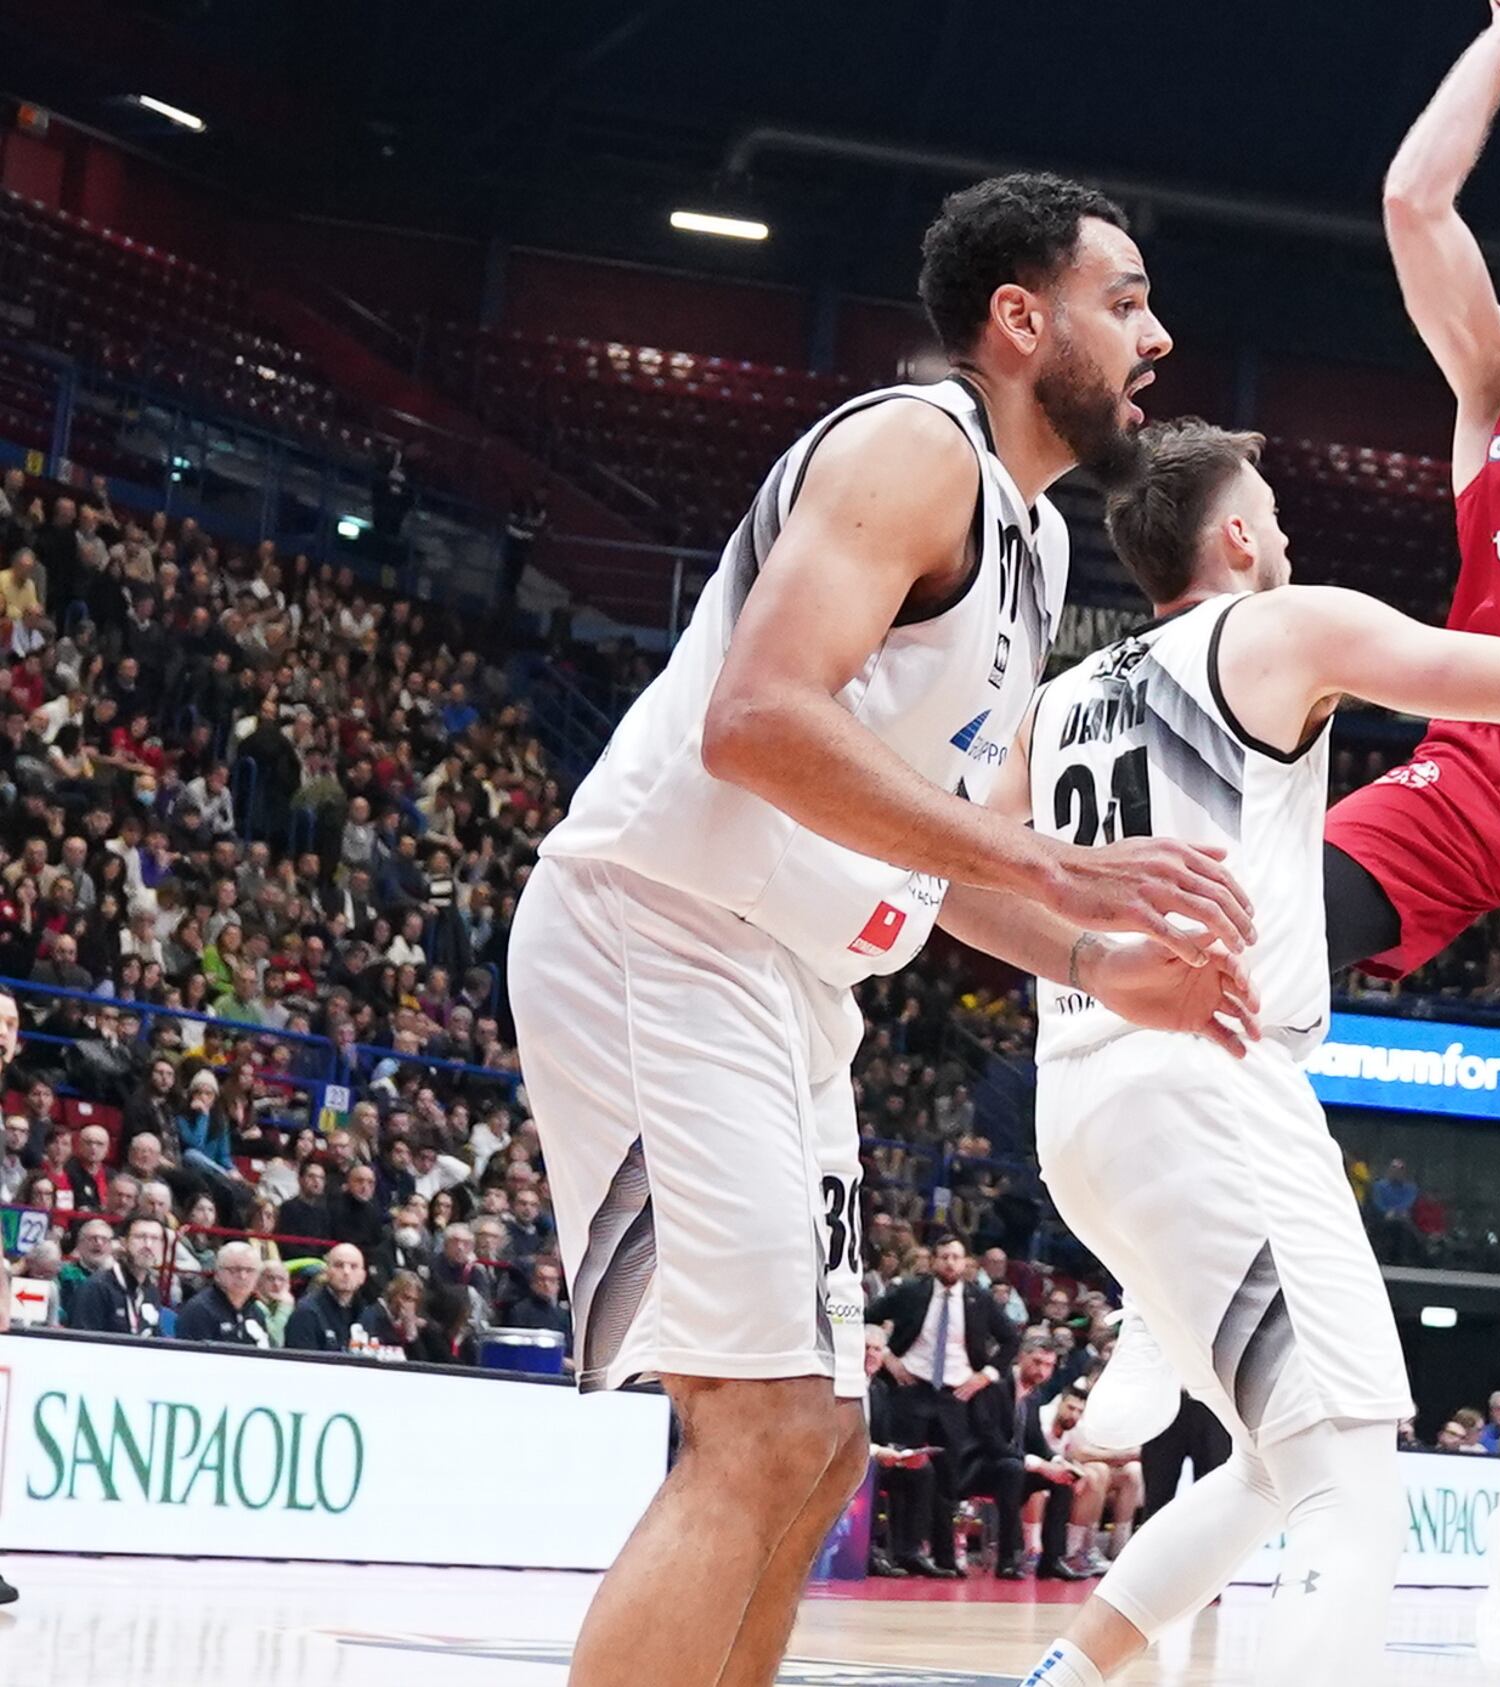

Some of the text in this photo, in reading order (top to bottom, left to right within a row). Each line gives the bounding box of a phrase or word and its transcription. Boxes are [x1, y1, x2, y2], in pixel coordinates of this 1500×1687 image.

[23, 1217, 44, 1244] 22
[26, 1390, 364, 1514] SANPAOLO
[1403, 1486, 1500, 1556] ANPAO
